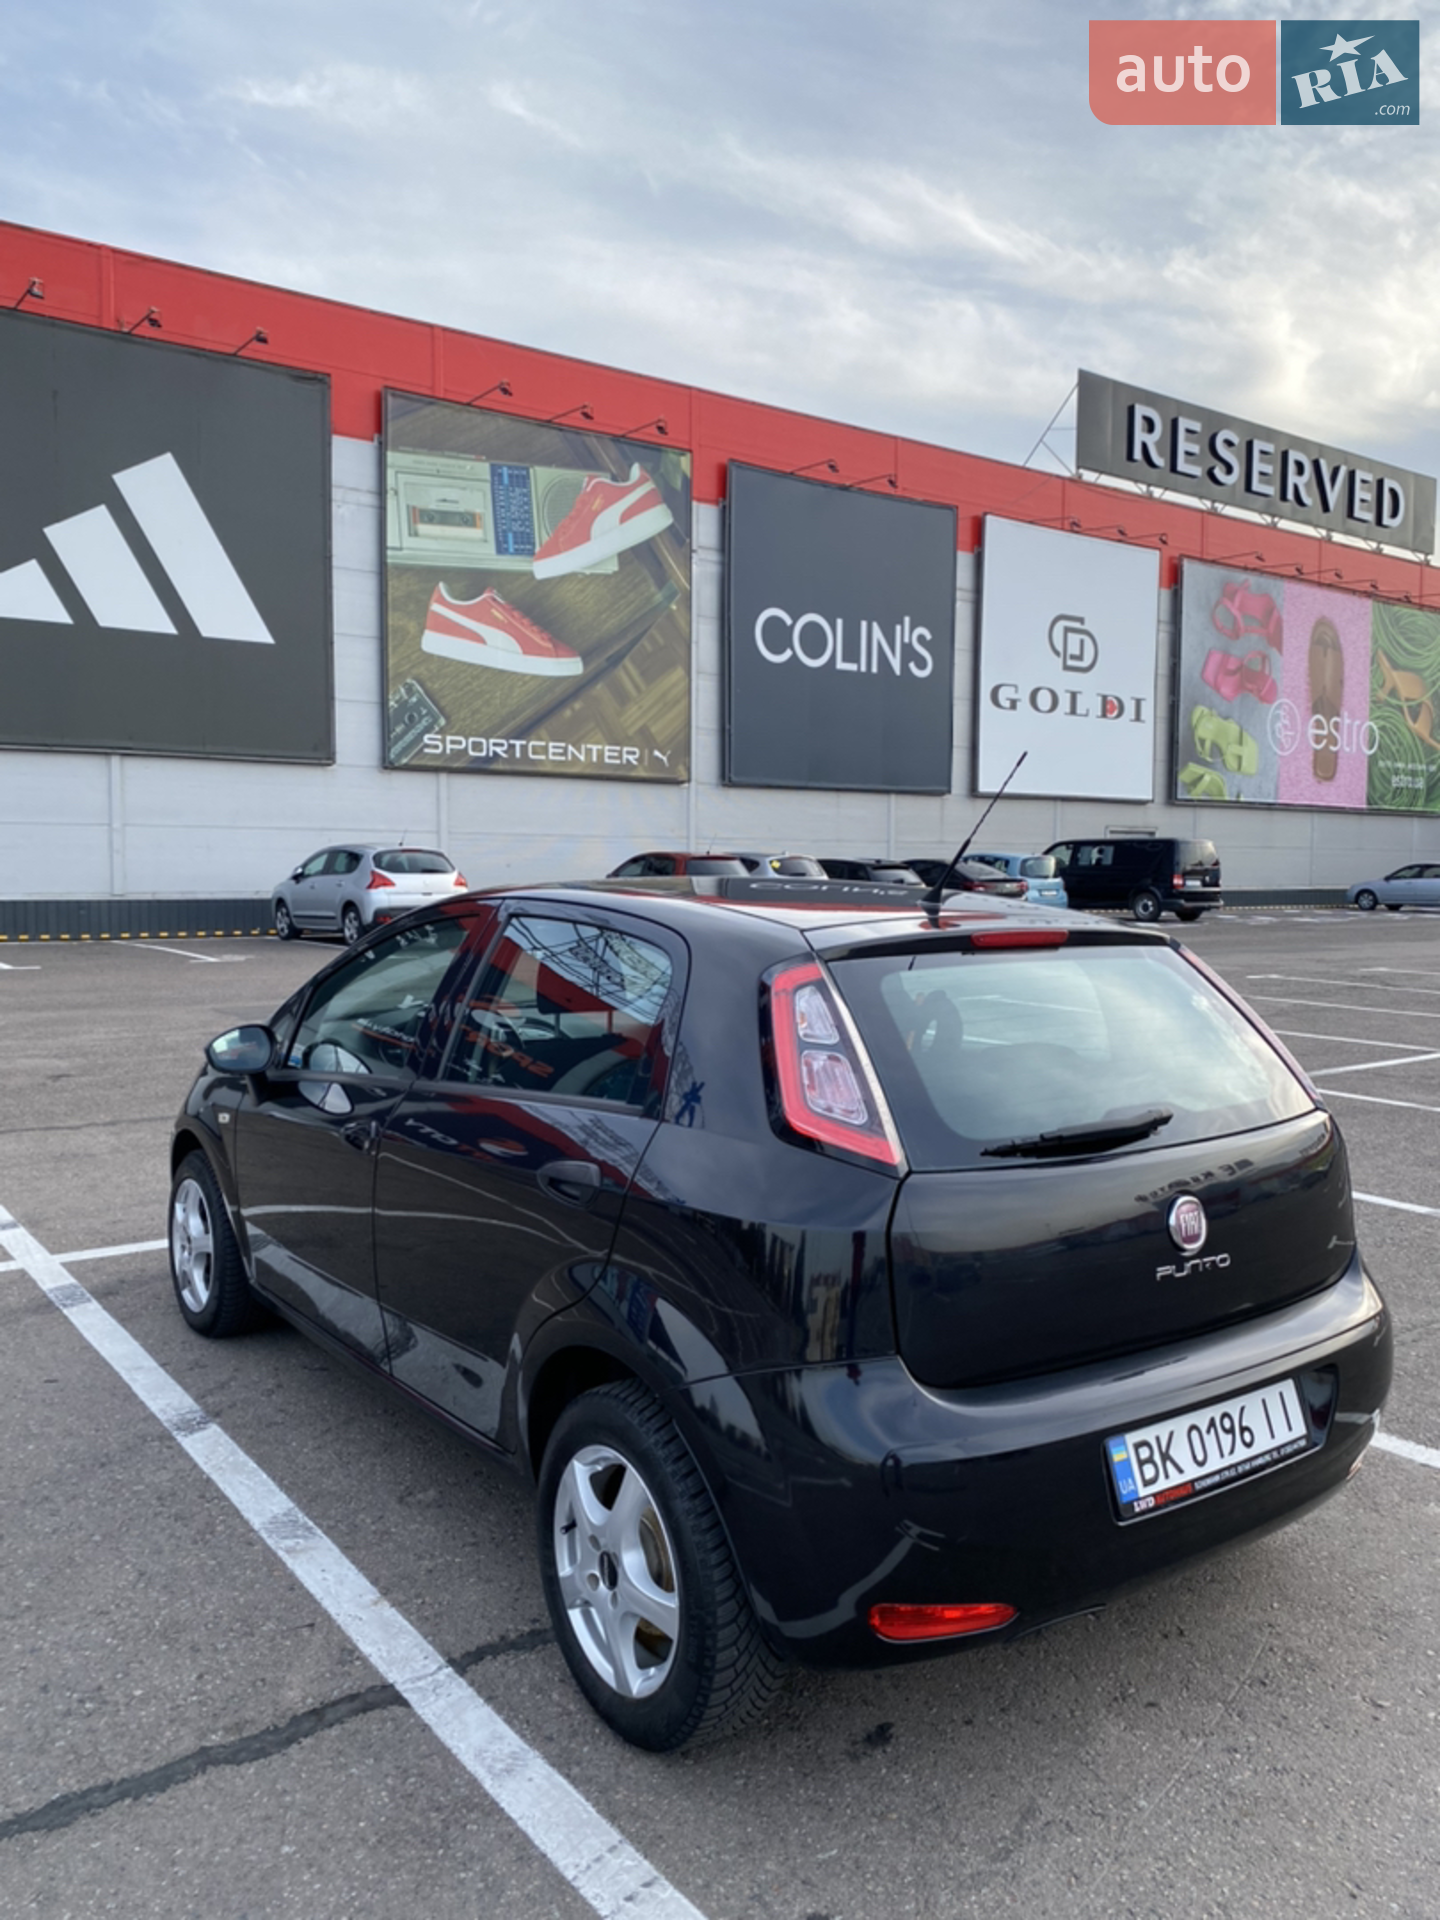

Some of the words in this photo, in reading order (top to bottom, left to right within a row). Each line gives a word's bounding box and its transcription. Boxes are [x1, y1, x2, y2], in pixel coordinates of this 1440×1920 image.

[1126, 402, 1406, 529] RESERVED
[754, 606, 934, 679] COLIN'S
[989, 682, 1147, 724] GOLDI
[422, 733, 640, 766] SPORTCENTER
[1307, 711, 1380, 756] estro
[1180, 1211, 1199, 1238] FIAT
[1155, 1253, 1231, 1281] PUNTO
[1132, 1429, 1185, 1489] BK
[1186, 1405, 1256, 1468] 0196
[1118, 1478, 1136, 1495] UA
